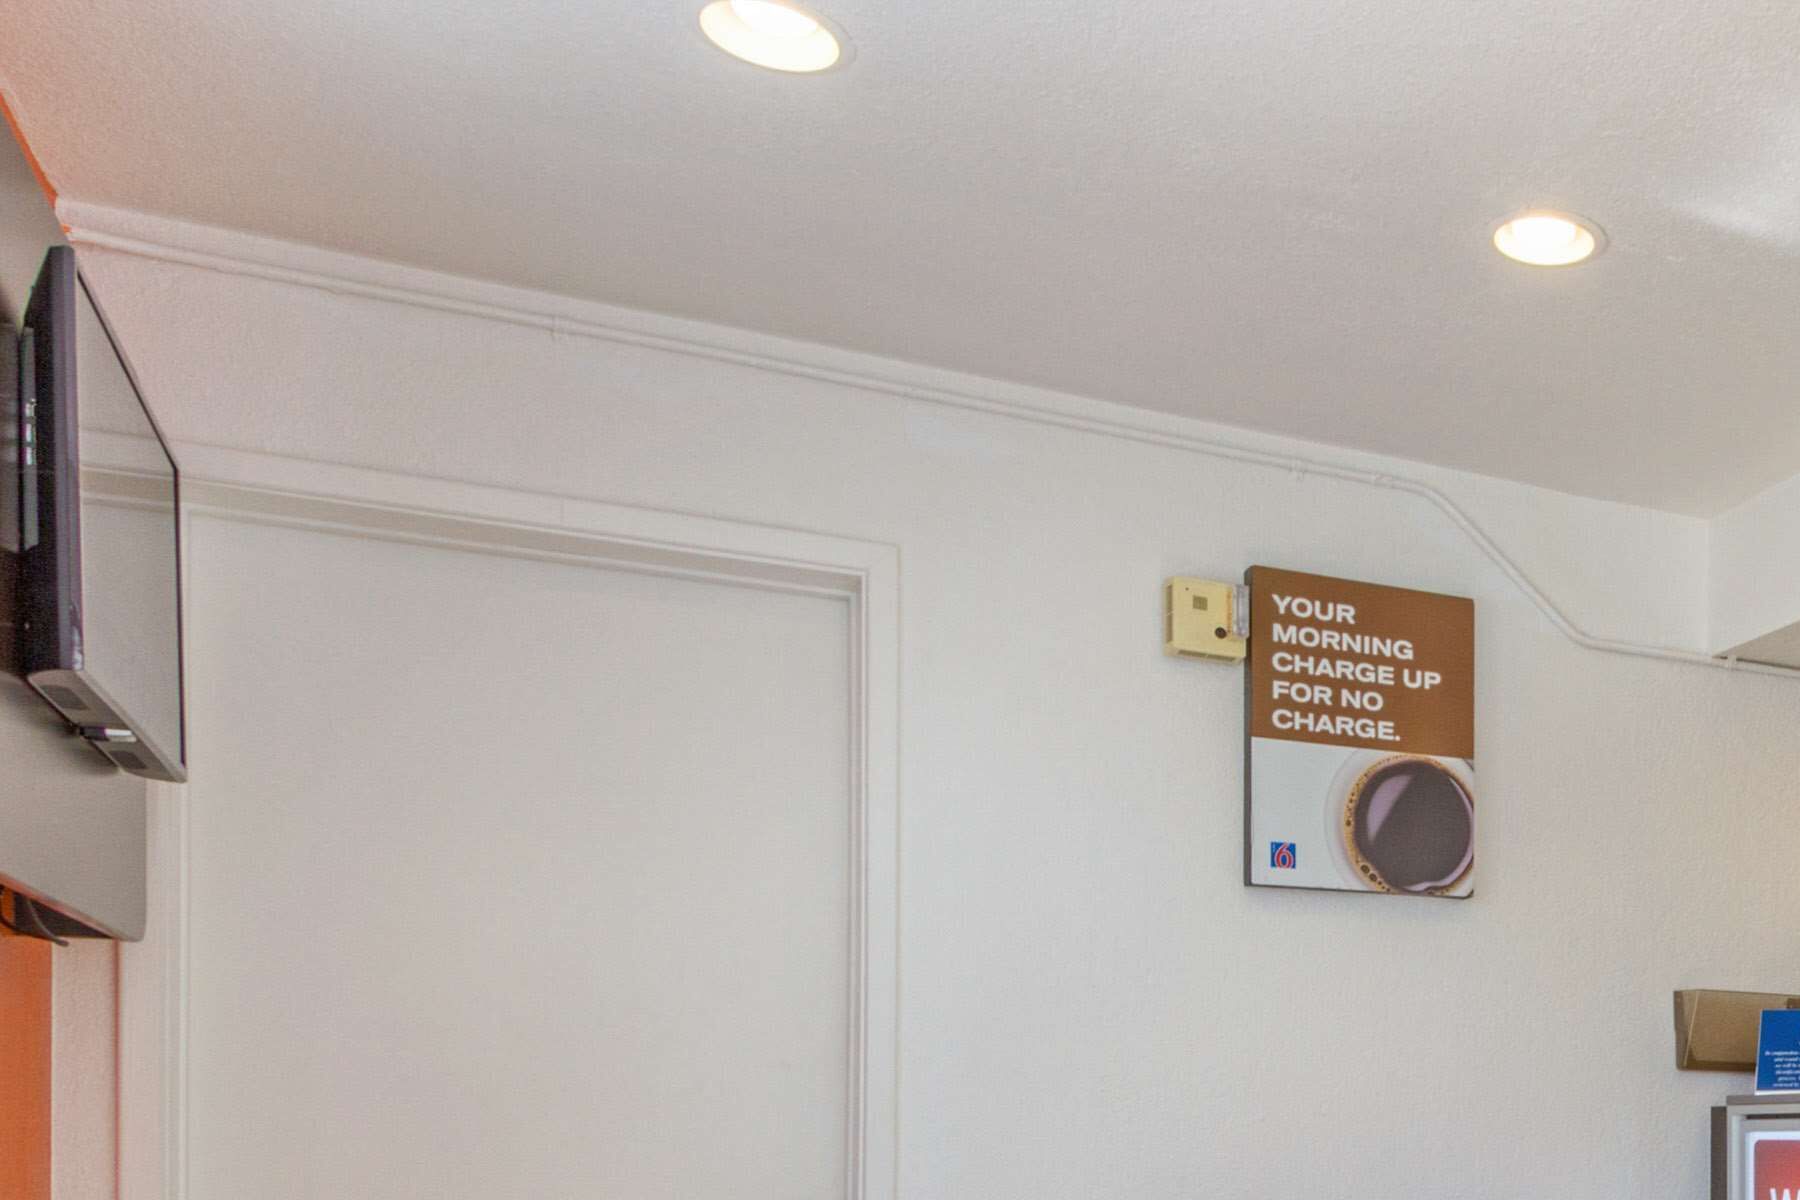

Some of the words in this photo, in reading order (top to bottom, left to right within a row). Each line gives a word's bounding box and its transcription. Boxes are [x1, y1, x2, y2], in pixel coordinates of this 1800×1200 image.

[1271, 593, 1356, 625] YOUR
[1271, 622, 1414, 661] MORNING
[1271, 651, 1395, 685] CHARGE
[1402, 668, 1441, 690] UP
[1271, 679, 1333, 706] FOR
[1340, 687, 1384, 712] NO
[1271, 708, 1401, 742] CHARGE.
